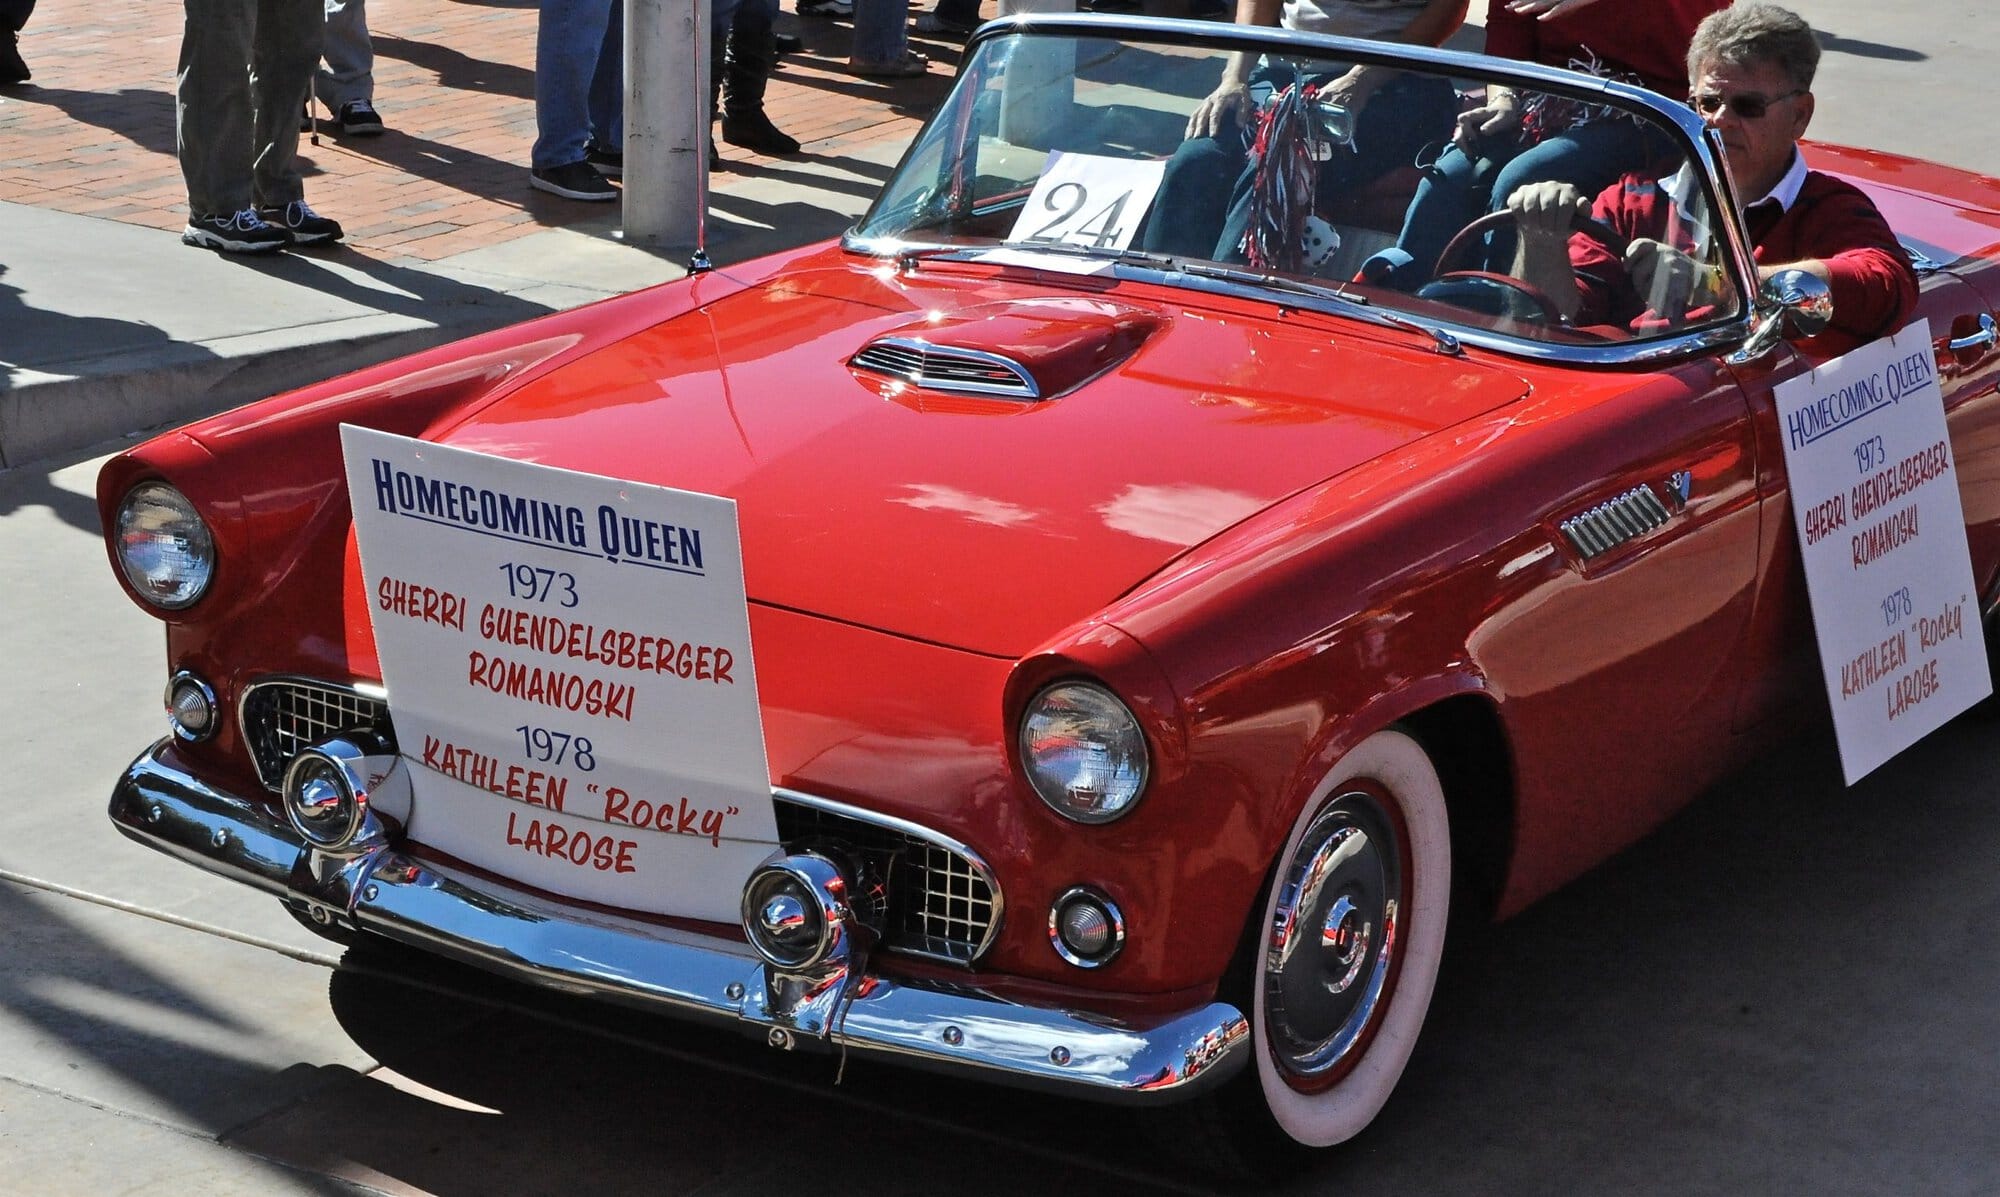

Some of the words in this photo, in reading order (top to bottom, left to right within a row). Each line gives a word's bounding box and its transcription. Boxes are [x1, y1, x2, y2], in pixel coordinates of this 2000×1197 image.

[1026, 182, 1133, 247] 24
[1788, 373, 1884, 451] HOMECOMING
[1886, 349, 1931, 403] QUEEN
[1853, 435, 1885, 474] 1973
[371, 458, 587, 548] HOMECOMING
[600, 504, 704, 569] QUEEN
[1805, 494, 1846, 545] SHERRI
[1851, 440, 1948, 518] GUENDELSBERGER
[1851, 503, 1919, 570] ROMANOSKI
[499, 562, 579, 608] 1973
[1880, 586, 1913, 627] 1978
[378, 576, 466, 632] SHERRI
[479, 603, 735, 684] GUENDELSBERGER
[468, 651, 636, 721] ROMANOSKI
[1841, 629, 1907, 701] KATHLEEN
[1887, 659, 1939, 720] LAROSE
[422, 734, 568, 812] KATHLEEN
[515, 724, 596, 772] 1978
[505, 812, 638, 873] LAROSE
